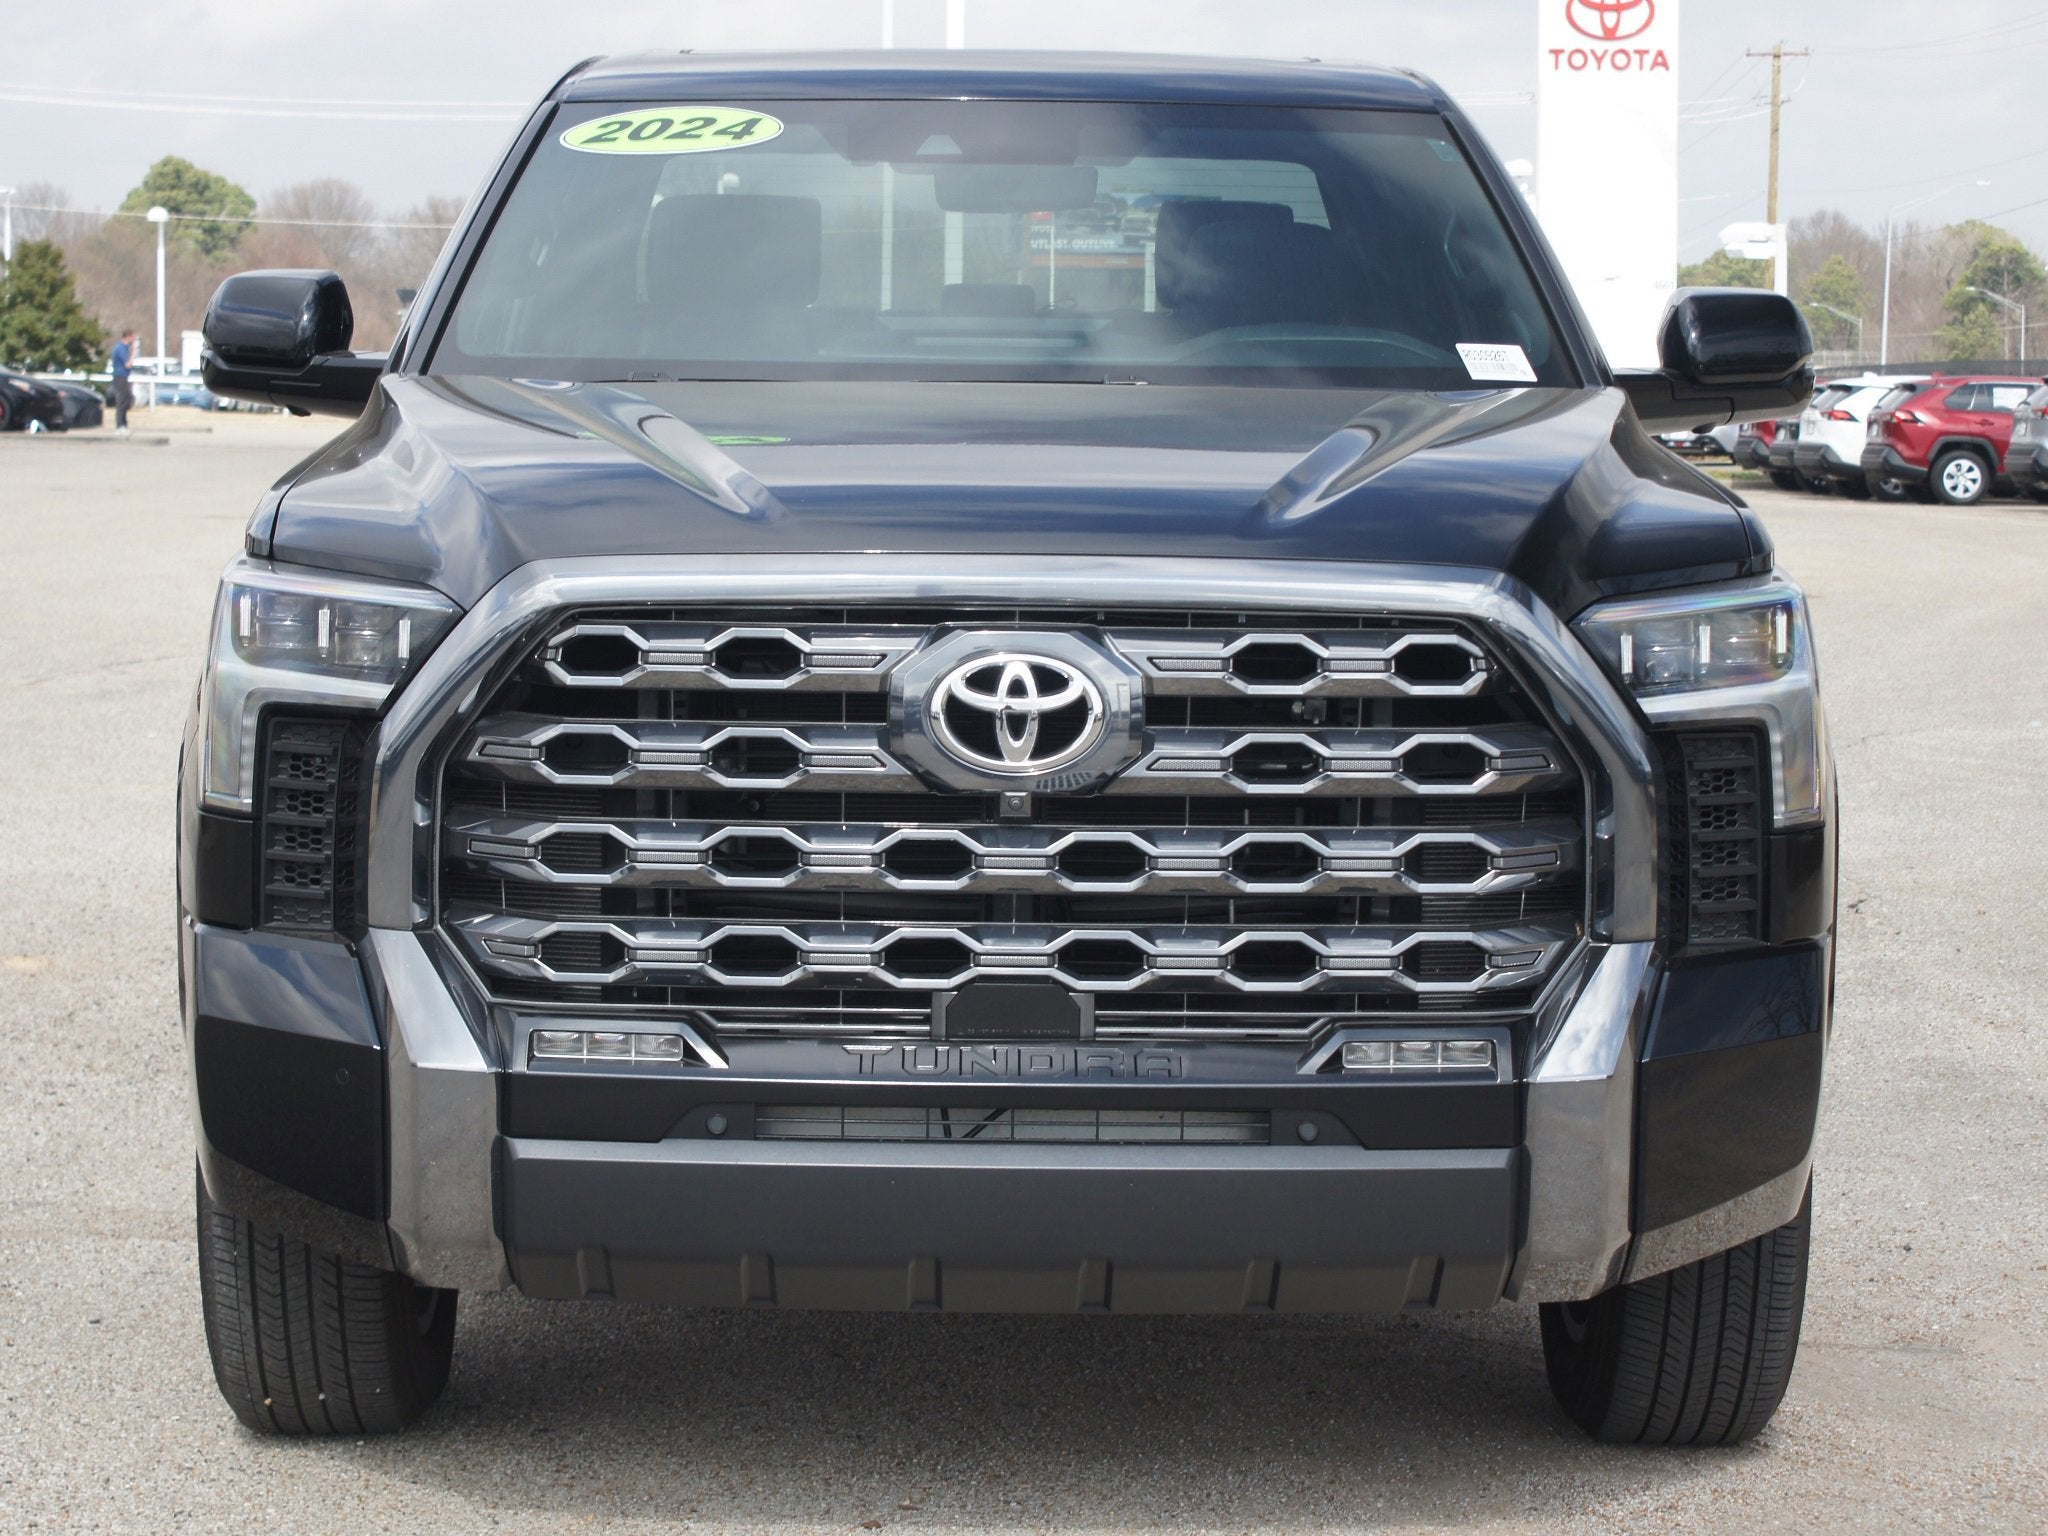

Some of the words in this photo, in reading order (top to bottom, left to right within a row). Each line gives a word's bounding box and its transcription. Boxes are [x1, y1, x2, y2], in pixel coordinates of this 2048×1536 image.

[1548, 48, 1670, 72] TOYOTA
[579, 116, 765, 145] 2024
[842, 1044, 1184, 1078] TUNDRA
